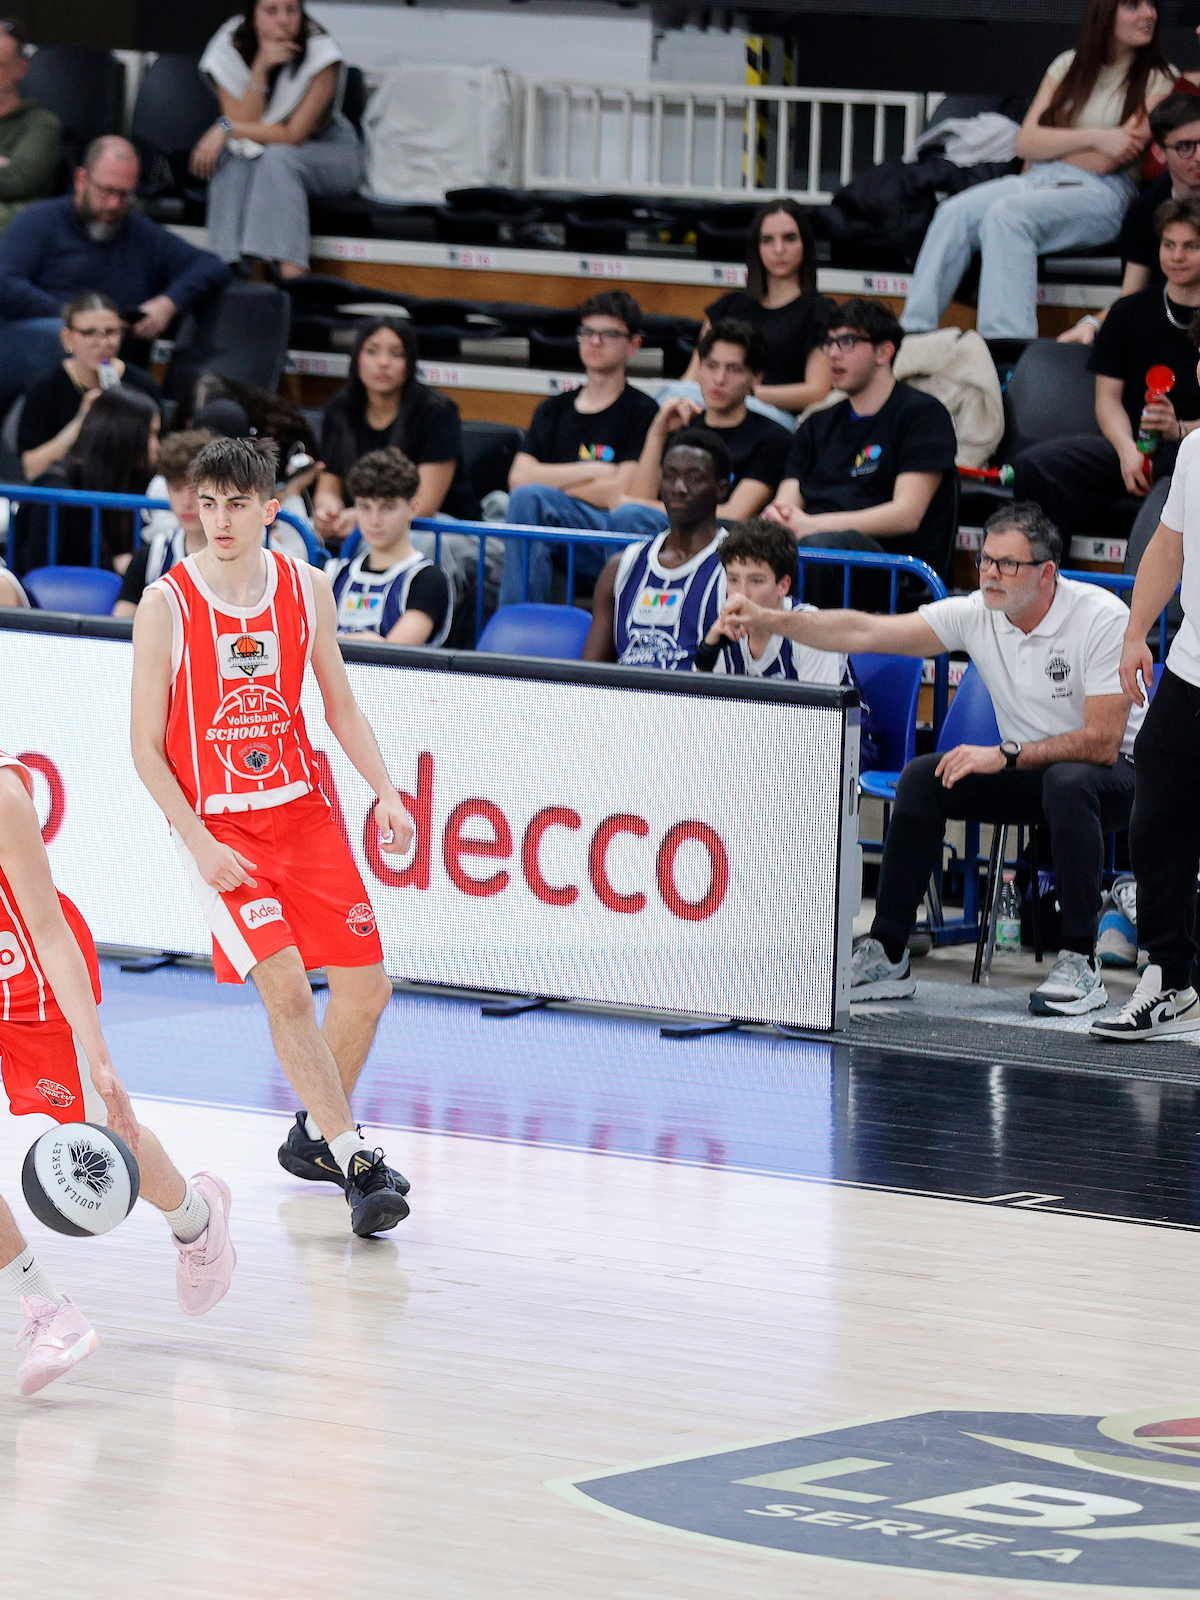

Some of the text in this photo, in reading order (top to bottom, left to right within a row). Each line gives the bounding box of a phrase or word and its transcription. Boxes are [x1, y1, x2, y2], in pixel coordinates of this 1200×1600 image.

[205, 724, 269, 741] SCHOOL
[226, 711, 279, 726] Volksbank
[52, 1141, 102, 1210] AQUILA BASKET
[744, 1504, 1084, 1565] SERIE A
